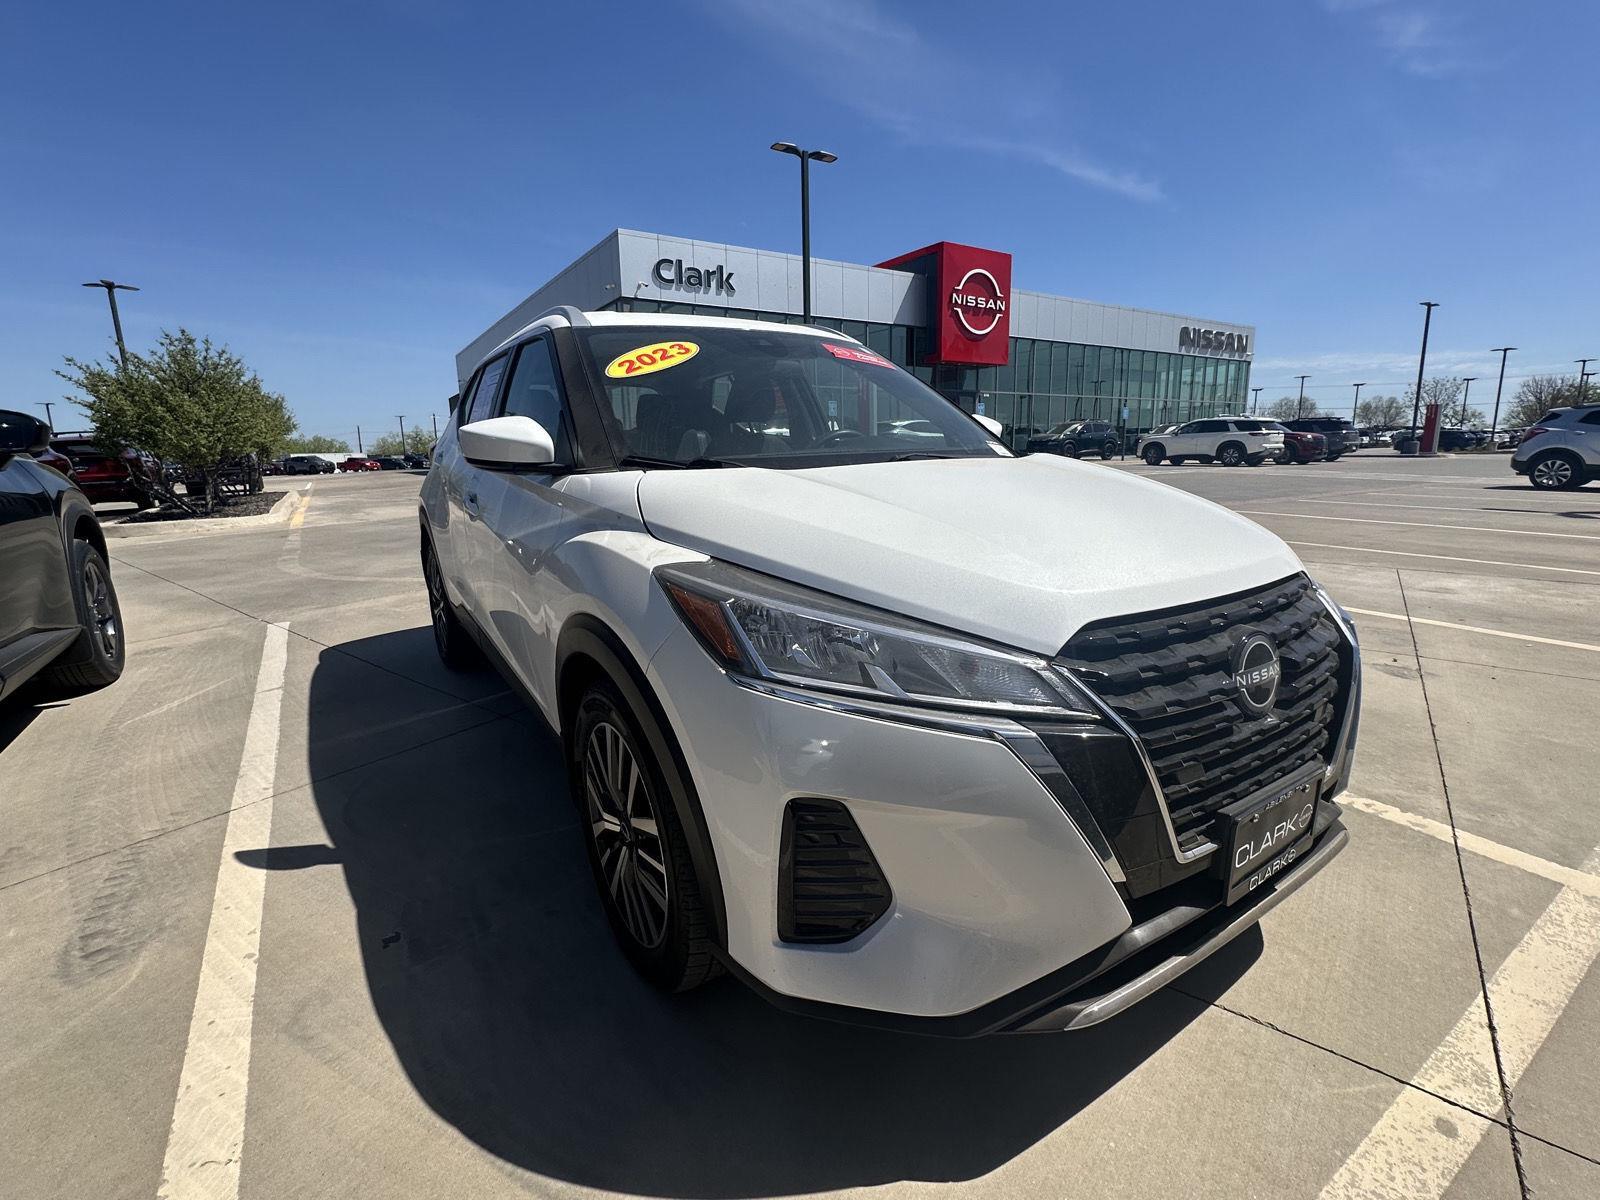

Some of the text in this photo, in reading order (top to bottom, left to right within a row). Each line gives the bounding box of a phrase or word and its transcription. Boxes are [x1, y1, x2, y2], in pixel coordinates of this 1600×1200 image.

[652, 258, 736, 296] Clark
[952, 292, 1006, 311] NISSAN
[1179, 326, 1249, 355] NISSAN
[617, 343, 692, 375] 2023
[1235, 661, 1280, 688] NISSAN
[1235, 812, 1299, 868] CLARK
[1249, 853, 1288, 891] CLARK
